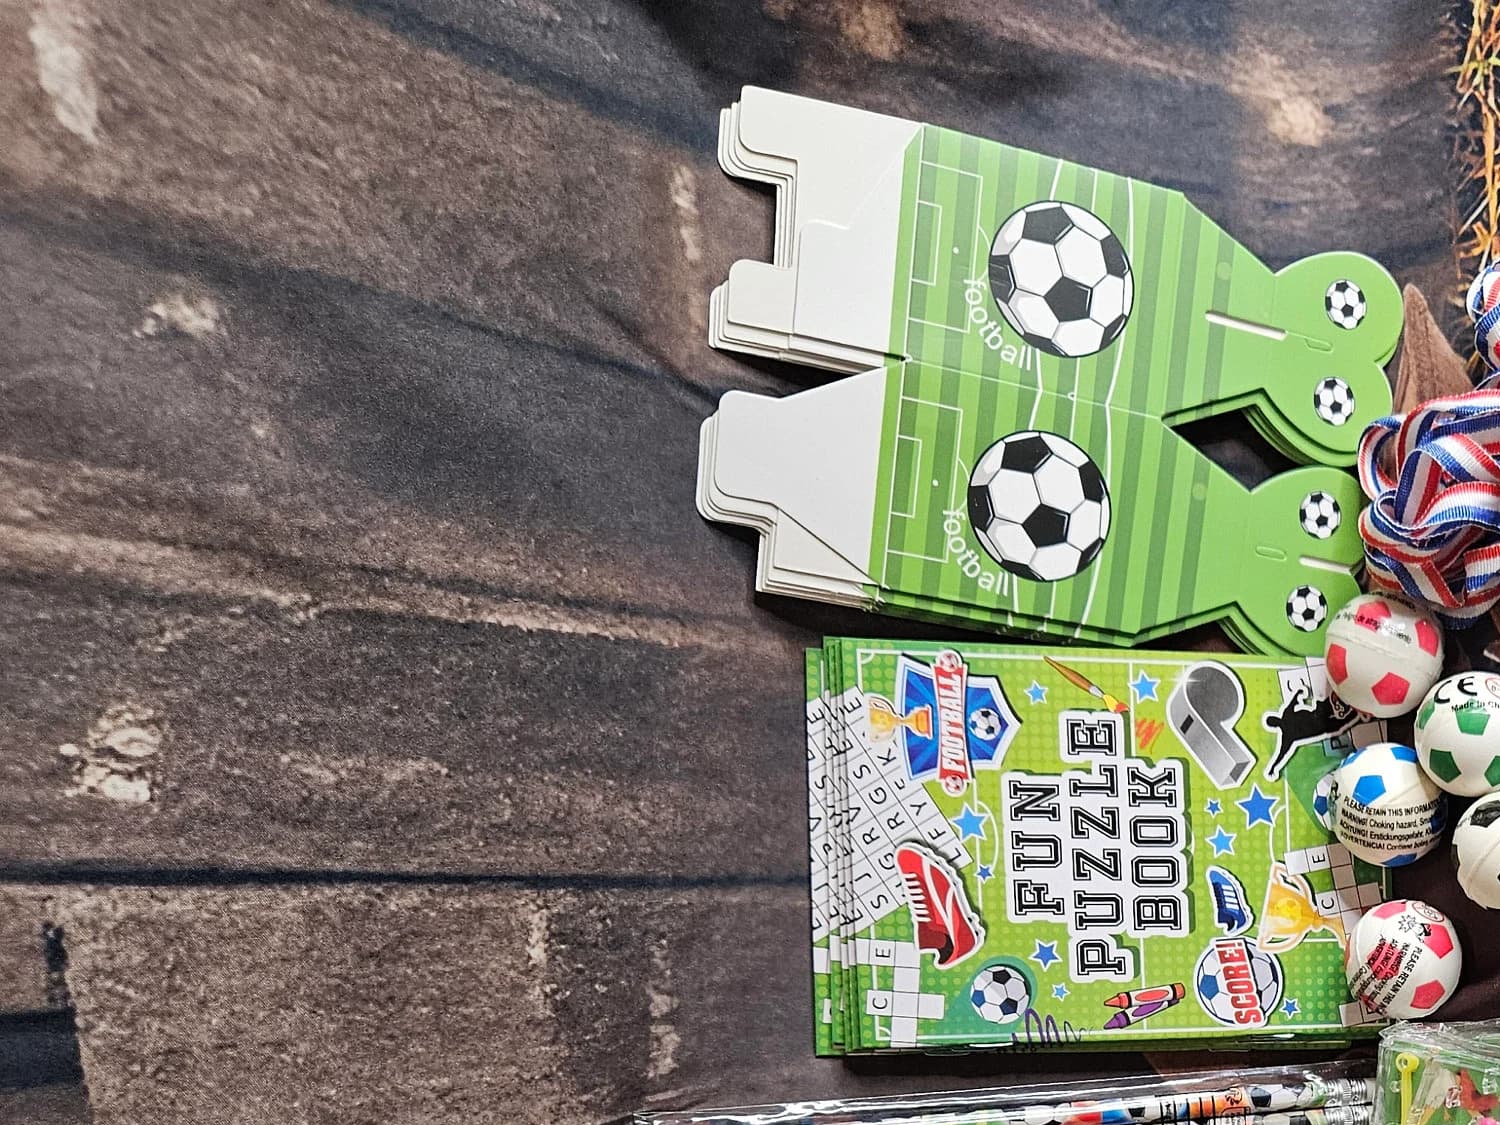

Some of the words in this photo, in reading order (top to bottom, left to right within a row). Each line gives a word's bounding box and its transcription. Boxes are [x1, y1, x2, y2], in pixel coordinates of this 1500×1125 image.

[963, 279, 1032, 371] football
[942, 508, 1009, 597] football
[938, 672, 966, 773] FOOTBALL
[1451, 700, 1475, 712] Made
[1008, 779, 1065, 917] FUN
[1066, 718, 1127, 976] PUZZLE
[1127, 766, 1182, 931] BOOK
[1340, 819, 1368, 837] ACHTUNG!
[1341, 807, 1368, 826] WARNING!
[1369, 819, 1395, 831] Choking
[1343, 796, 1364, 813] PLEASE
[1365, 804, 1386, 817] RETAIN
[1387, 807, 1403, 817] THIS
[1215, 941, 1262, 1025] SCORE!
[1391, 970, 1409, 996] RETAIN
[1404, 945, 1423, 973] PLEASE
